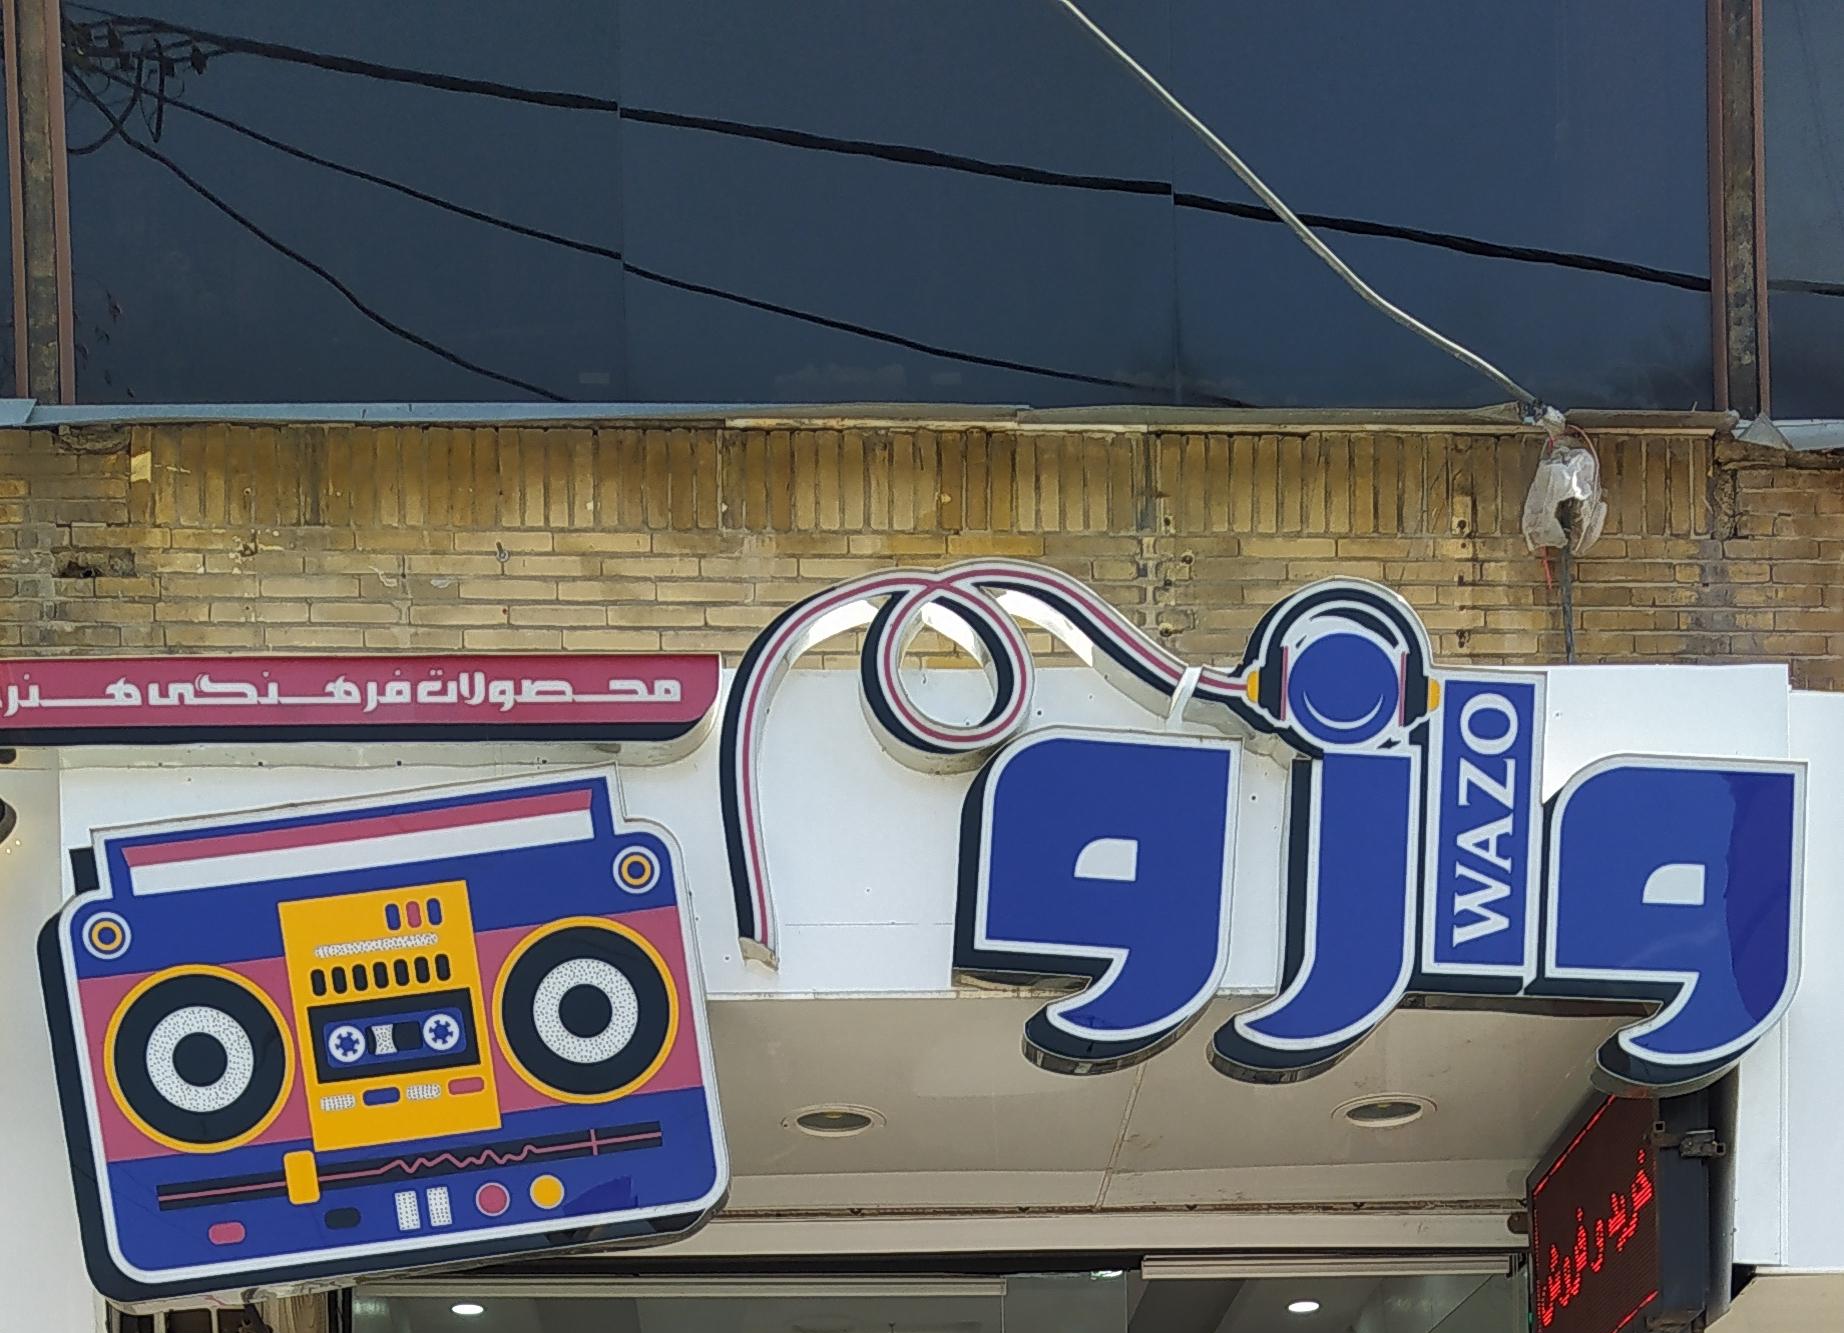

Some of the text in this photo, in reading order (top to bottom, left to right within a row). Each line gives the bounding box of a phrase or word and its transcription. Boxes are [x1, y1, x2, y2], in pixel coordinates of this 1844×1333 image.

[0, 669, 682, 717] محصولات فرهنگی هنر
[1453, 692, 1520, 949] WAZO
